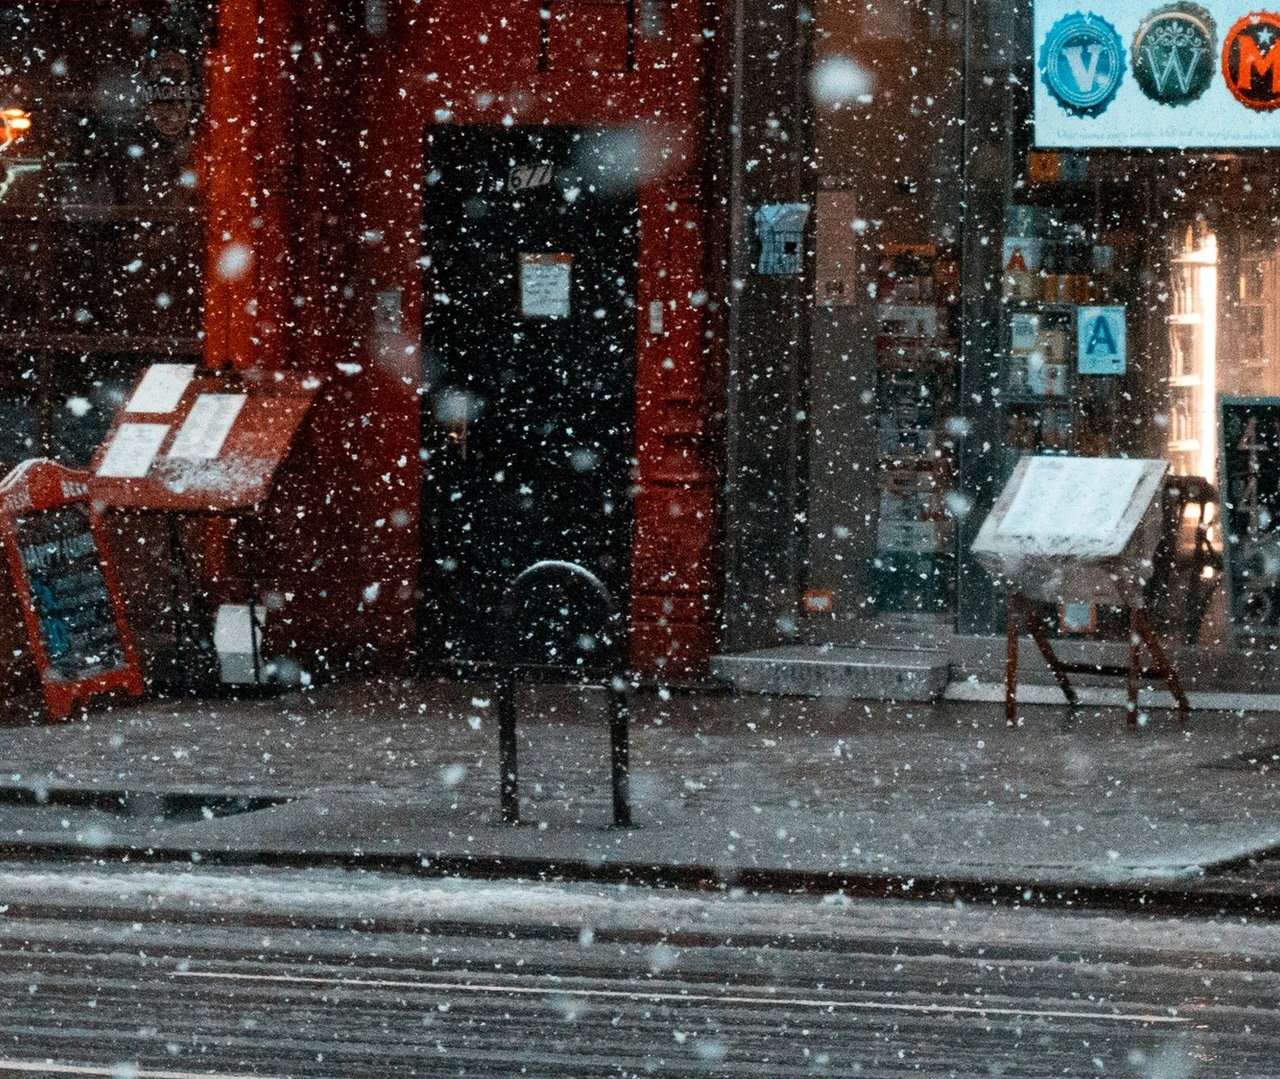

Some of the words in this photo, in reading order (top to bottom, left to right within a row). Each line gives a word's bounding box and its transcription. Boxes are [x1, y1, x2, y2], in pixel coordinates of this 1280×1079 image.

[1062, 44, 1105, 92] V
[1142, 45, 1204, 93] W
[1087, 316, 1117, 354] A
